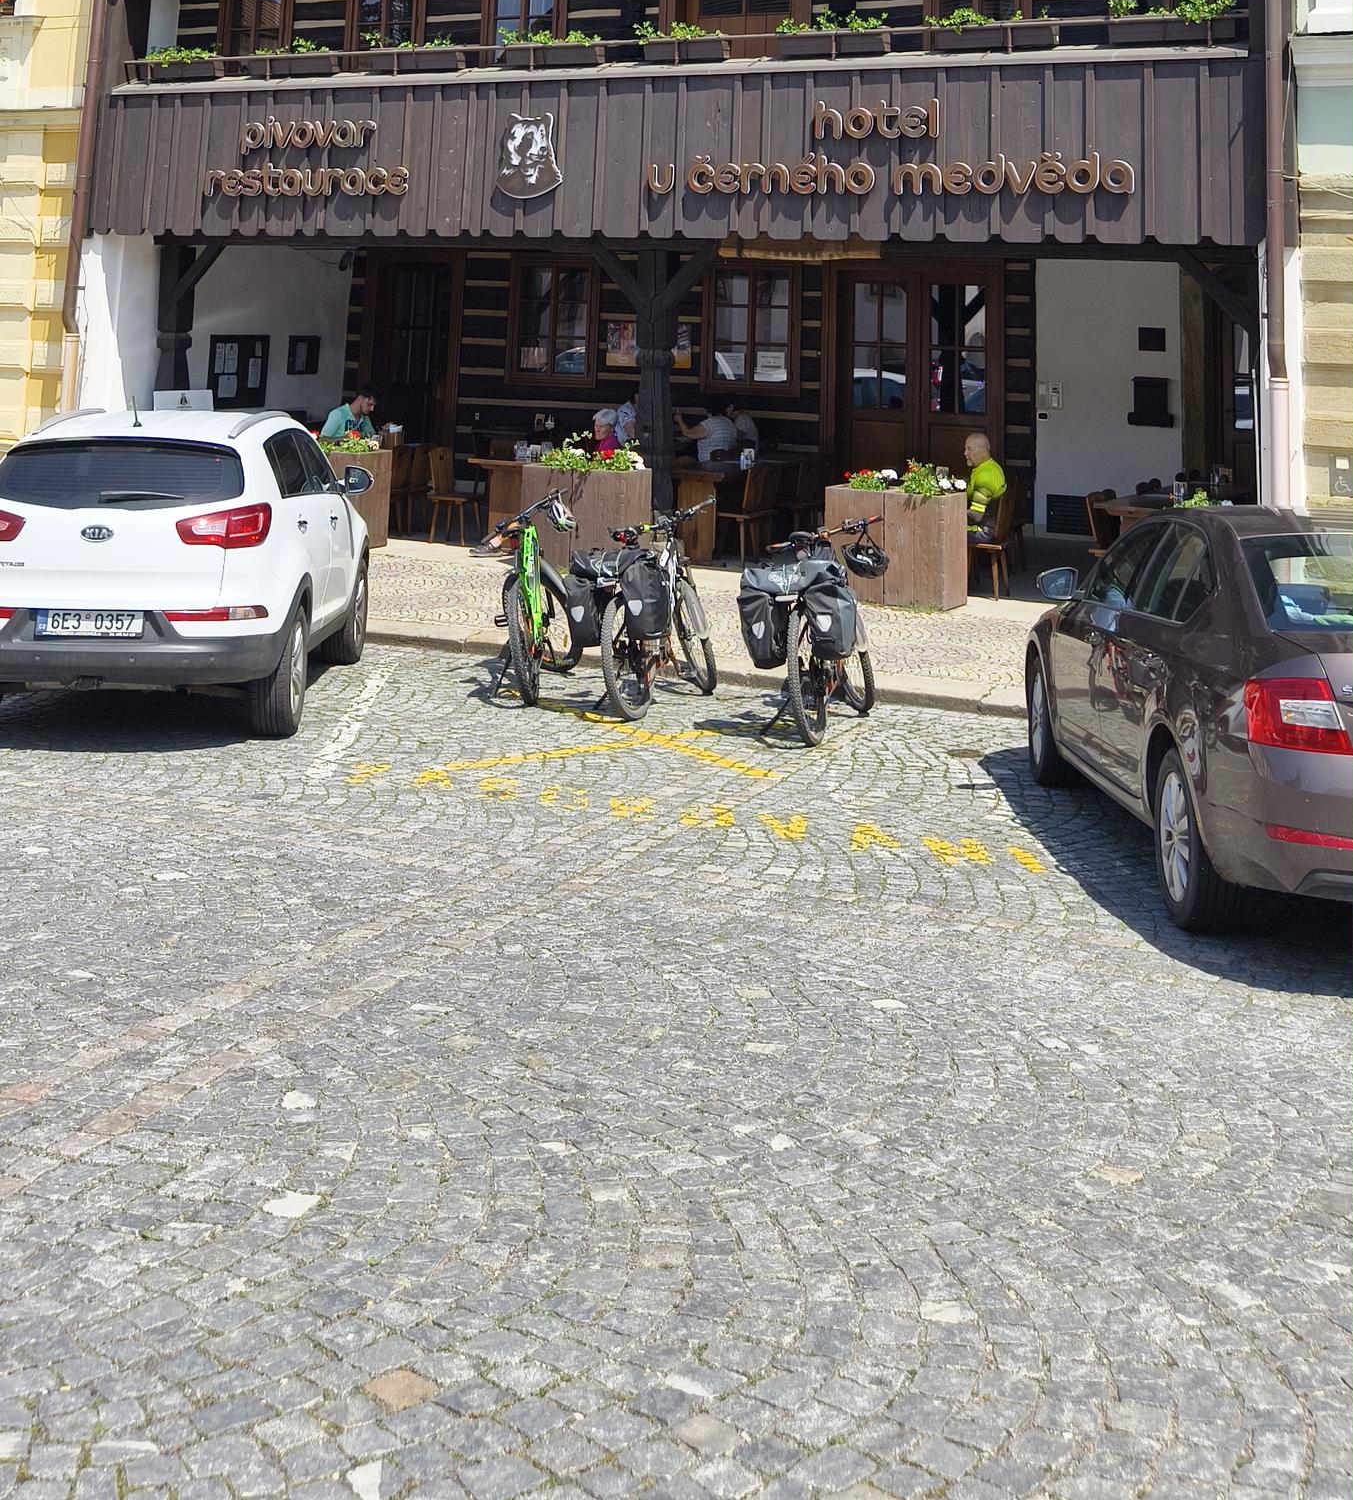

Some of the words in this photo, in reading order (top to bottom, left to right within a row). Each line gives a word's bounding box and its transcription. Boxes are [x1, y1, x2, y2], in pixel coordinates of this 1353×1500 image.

[241, 115, 377, 155] pivovar
[814, 98, 940, 140] hotel
[204, 162, 409, 197] restaurace
[648, 162, 675, 194] u
[687, 151, 876, 195] černého
[892, 151, 1135, 195] medvěda
[85, 528, 110, 539] KIA
[51, 612, 82, 630] 6E3
[94, 613, 136, 631] 0357
